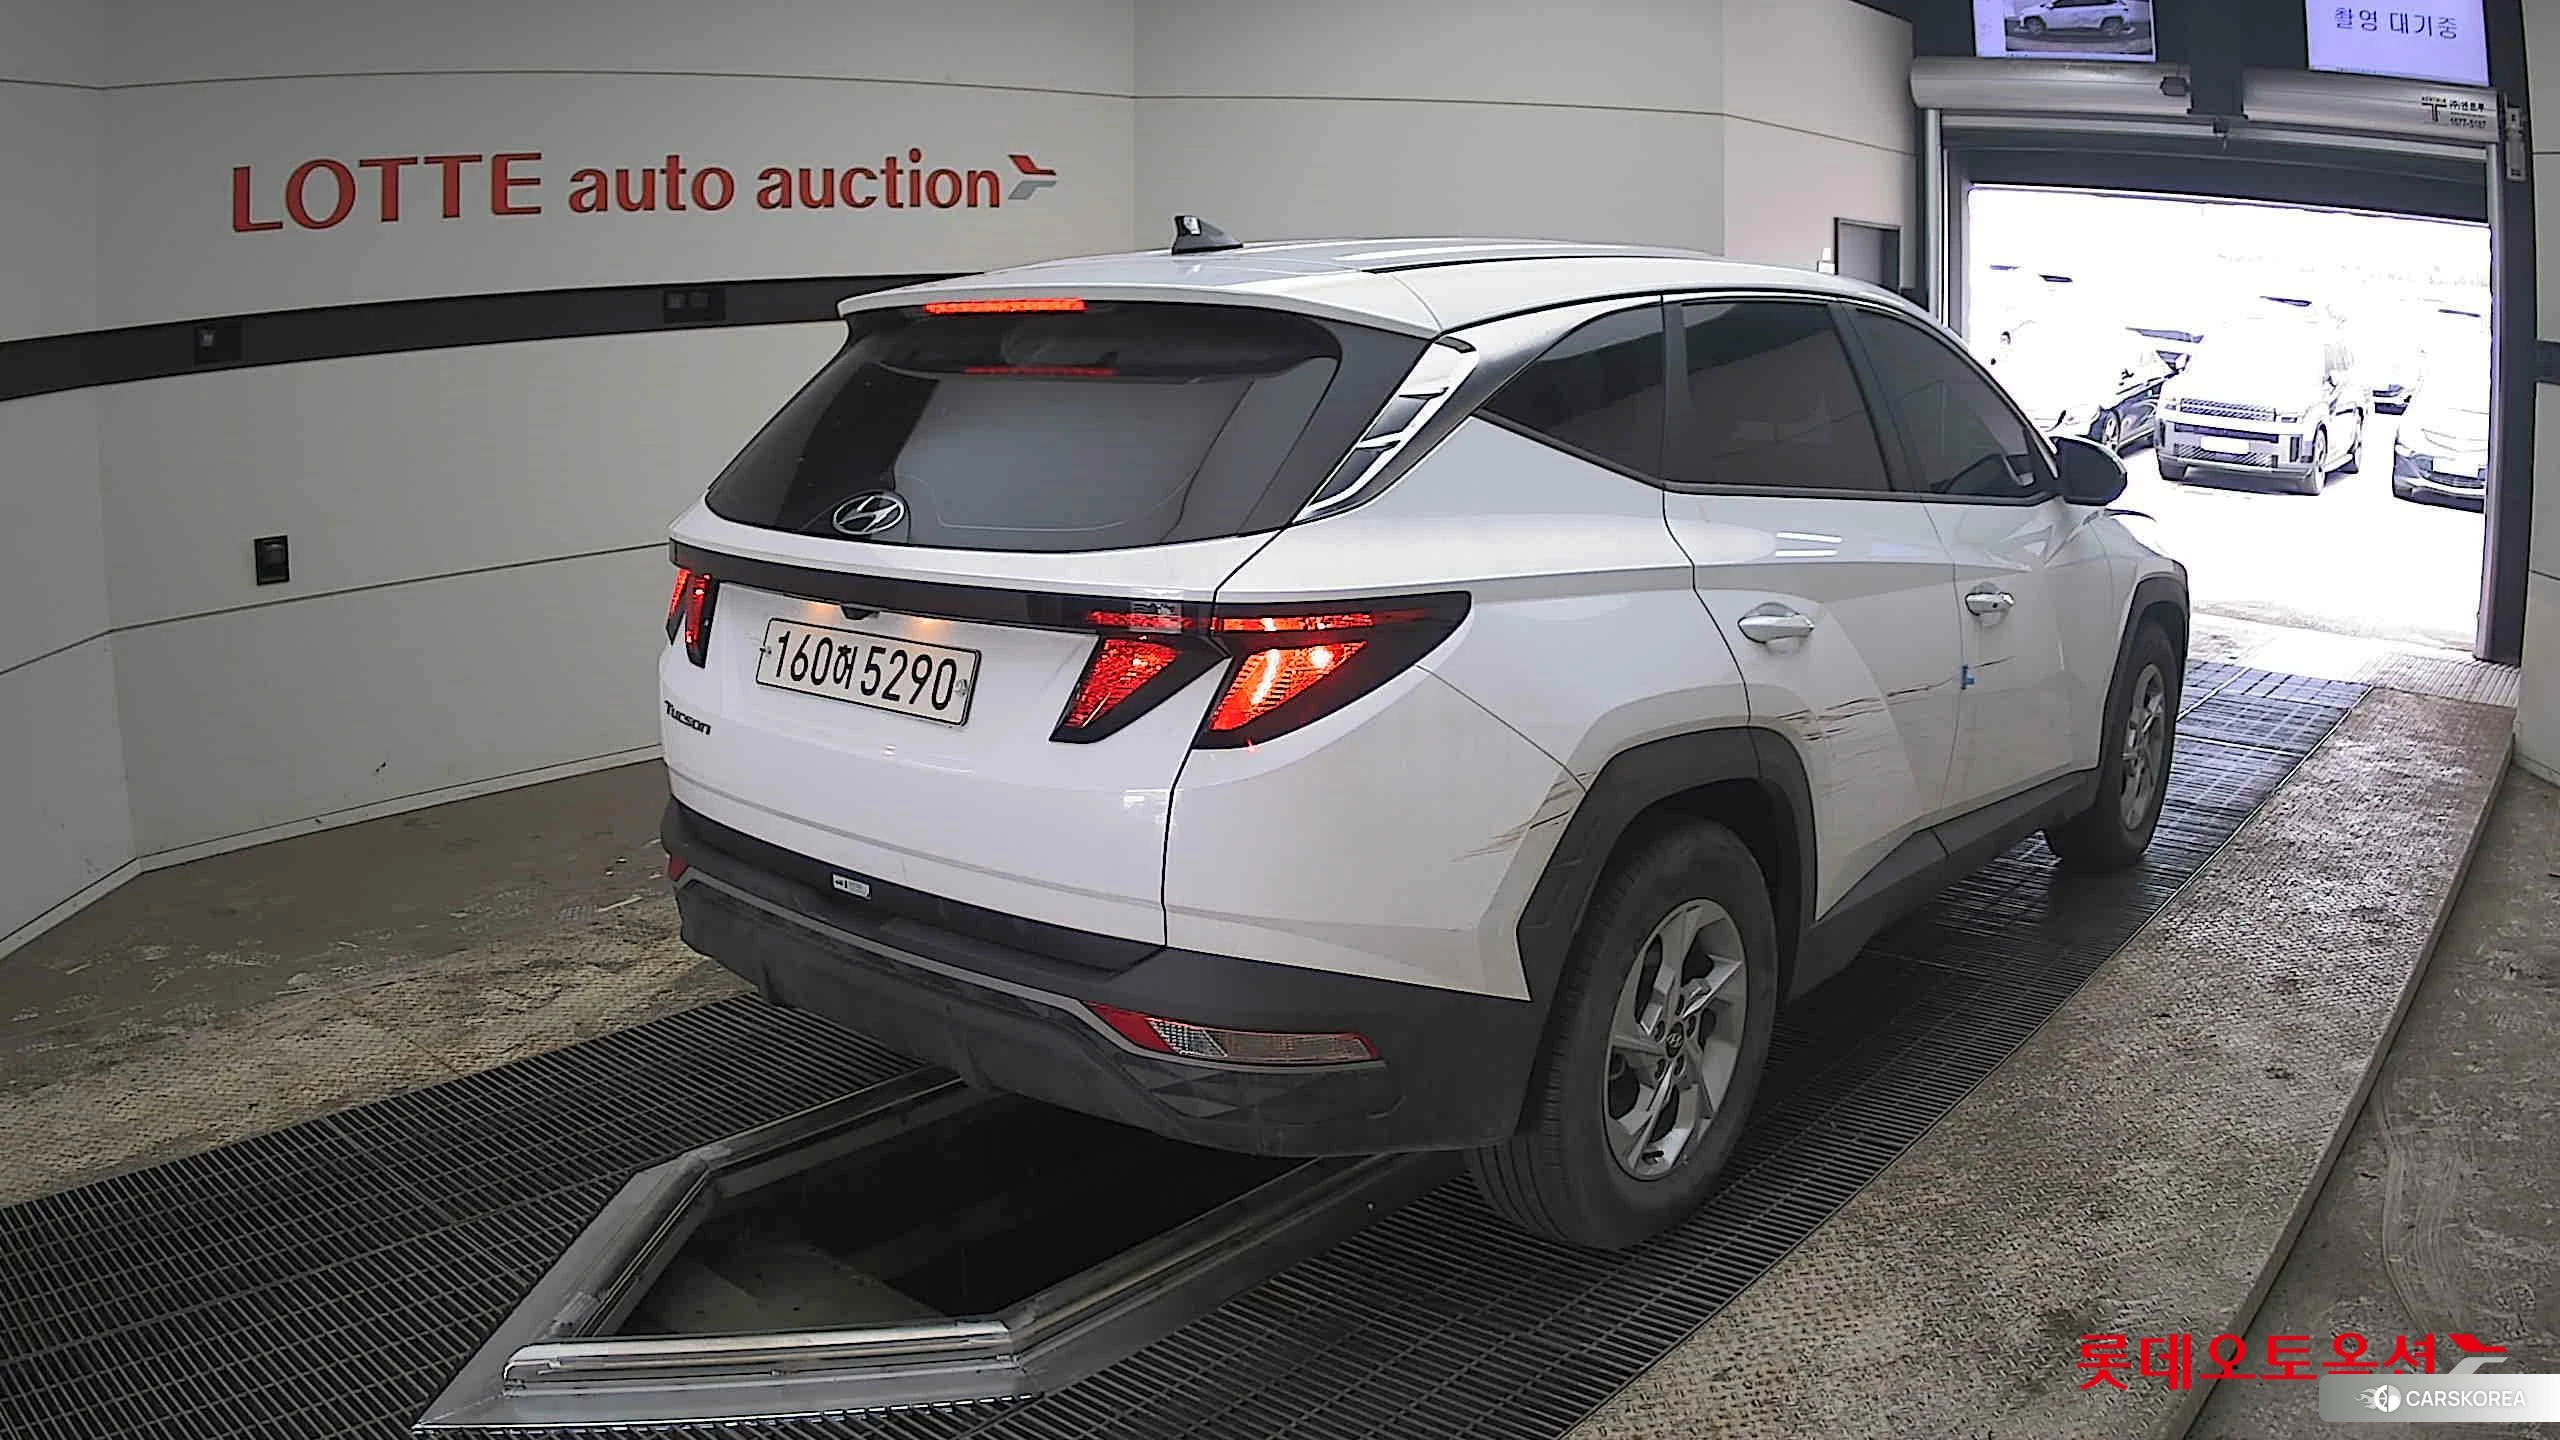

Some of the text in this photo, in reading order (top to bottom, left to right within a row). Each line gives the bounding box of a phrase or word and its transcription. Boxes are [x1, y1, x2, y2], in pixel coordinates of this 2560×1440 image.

[2335, 7, 2458, 40] 촬영 대기중
[233, 148, 1002, 232] LOTTE auto auction
[775, 630, 957, 711] 160허 5290
[664, 700, 711, 735] Tucson
